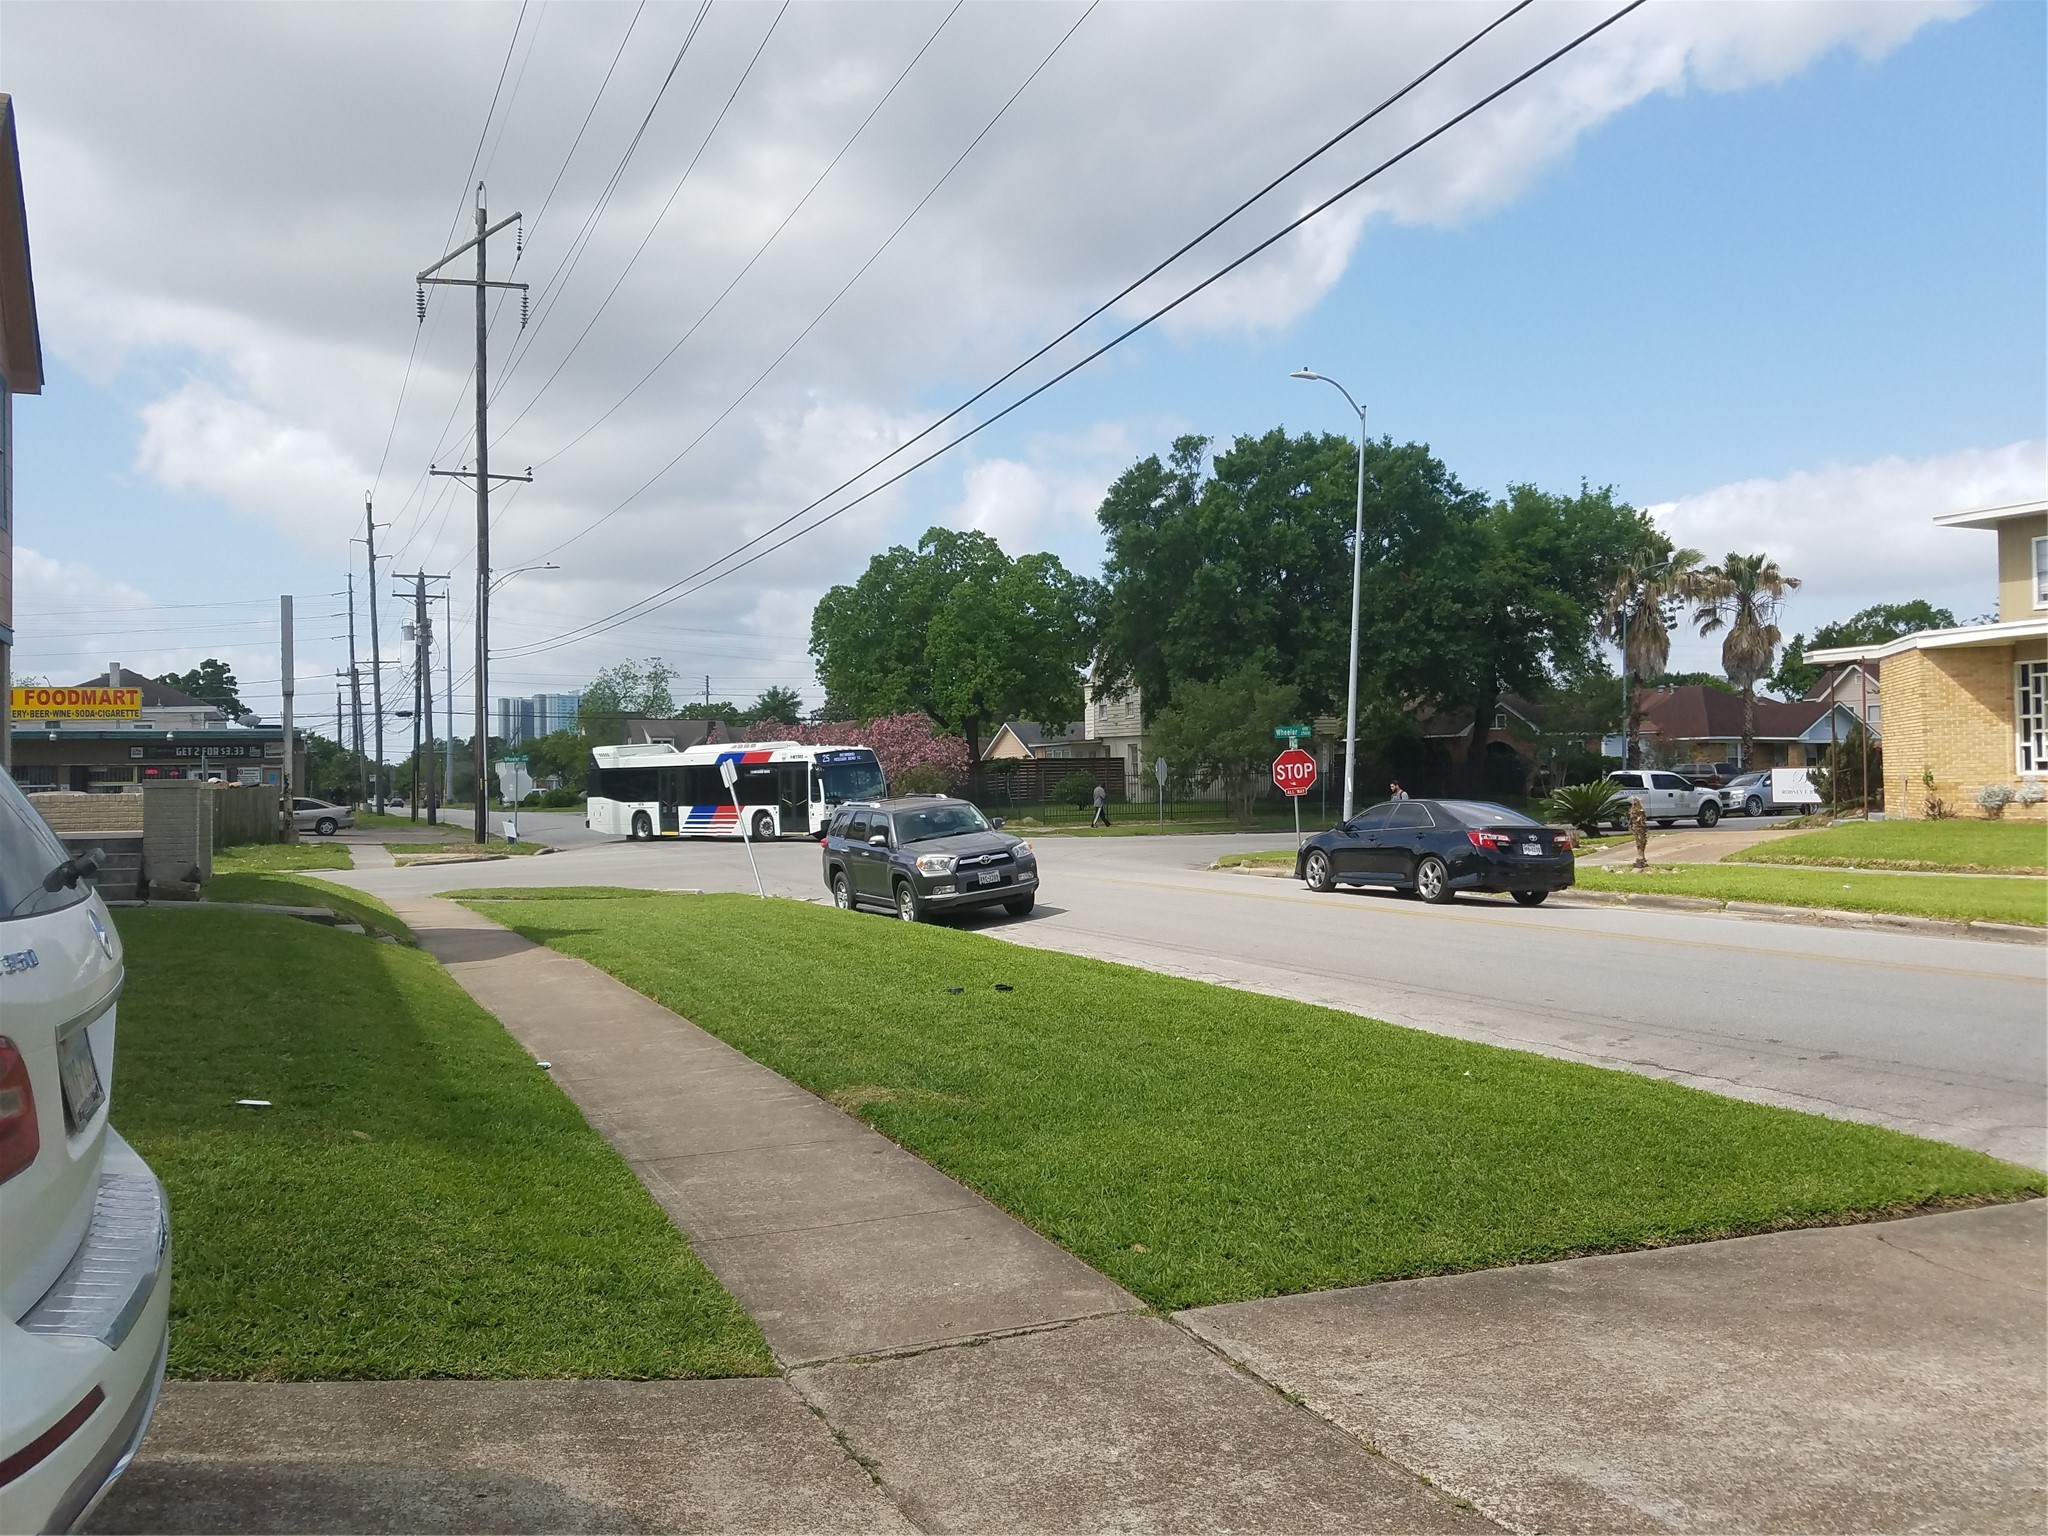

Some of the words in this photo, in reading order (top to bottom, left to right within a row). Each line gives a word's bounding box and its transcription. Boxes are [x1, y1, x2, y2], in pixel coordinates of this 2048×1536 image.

[24, 690, 138, 705] FOODMART
[30, 709, 50, 718] BEER
[53, 709, 72, 718] WINE
[75, 709, 95, 718] SODA
[97, 709, 140, 718] CIGARETTE
[1275, 728, 1298, 736] Wheeler
[176, 747, 192, 756] GET
[194, 747, 199, 756] 2
[202, 747, 219, 756] FOR
[220, 746, 244, 756] $3.33
[822, 754, 830, 763] 25
[1276, 762, 1312, 780] STOP
